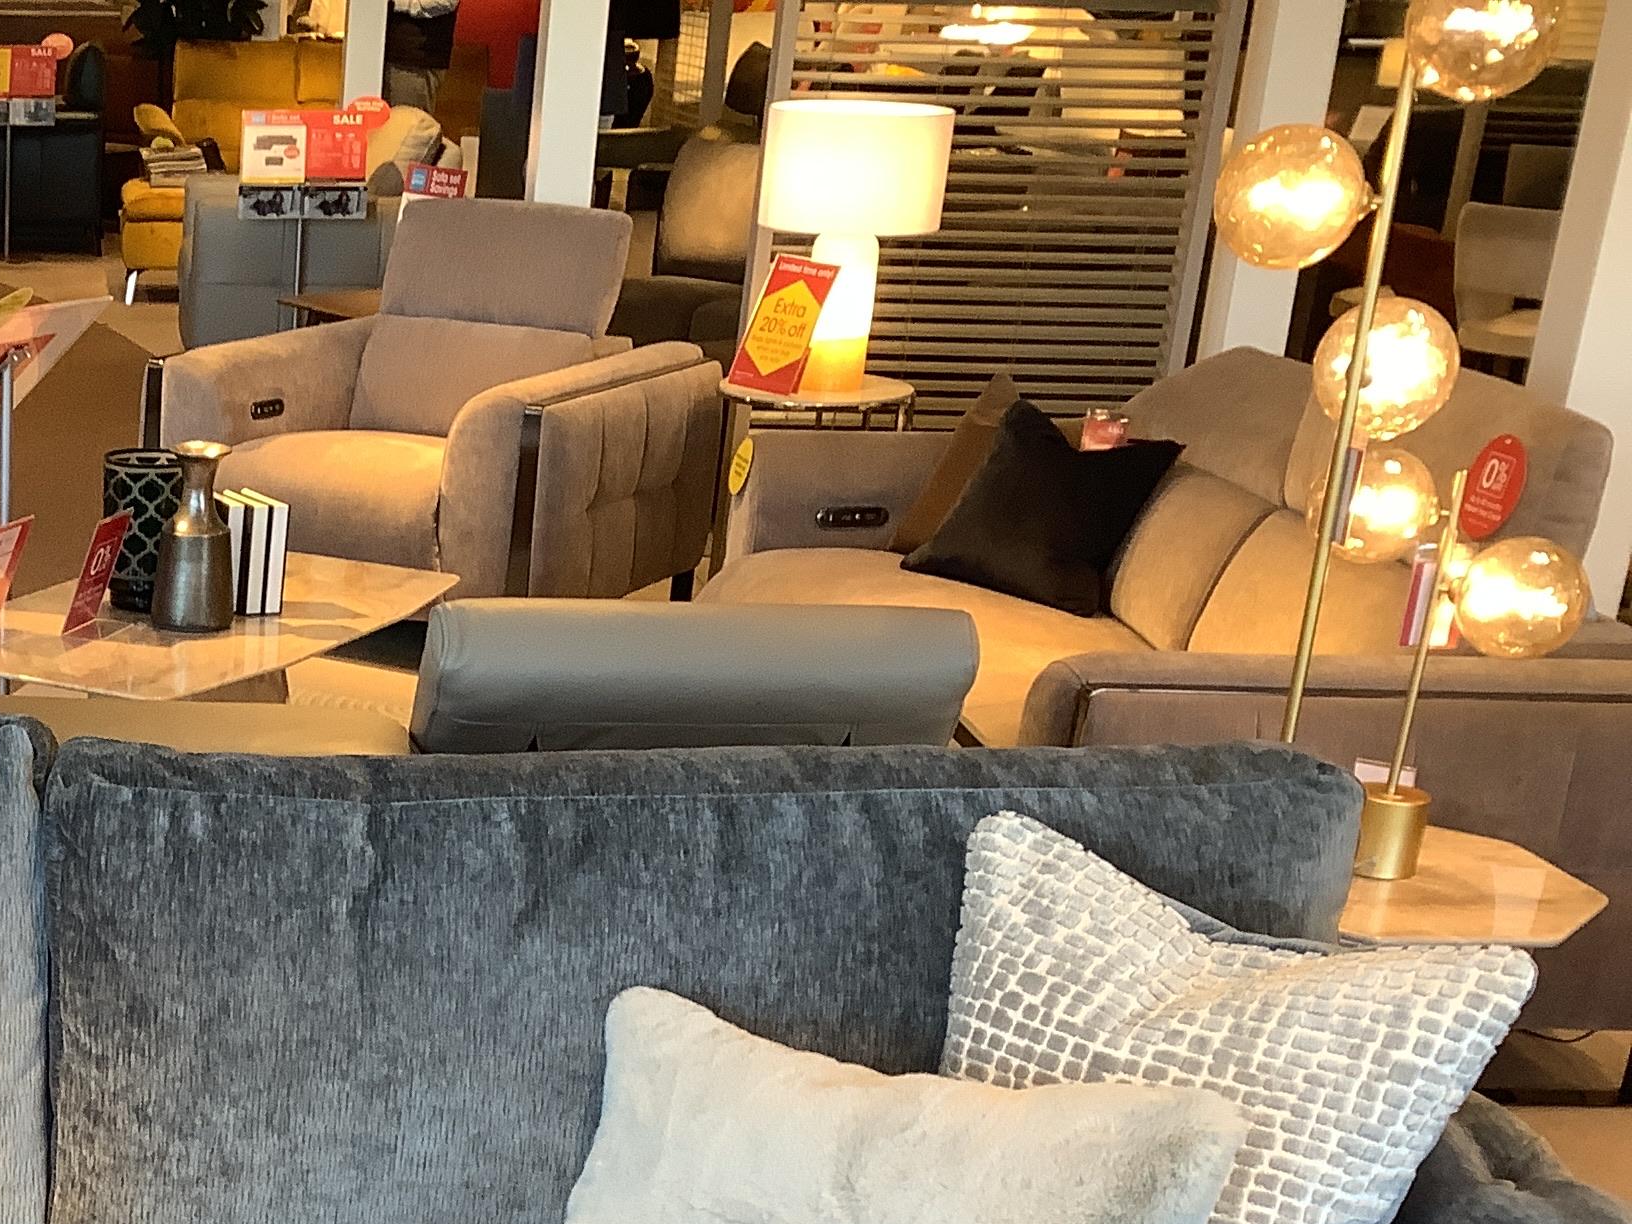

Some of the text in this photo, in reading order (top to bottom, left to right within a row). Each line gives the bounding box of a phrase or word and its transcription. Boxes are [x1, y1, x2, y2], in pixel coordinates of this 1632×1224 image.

[333, 114, 363, 125] SALE
[773, 297, 807, 318] Extra
[759, 316, 806, 339] 20% off
